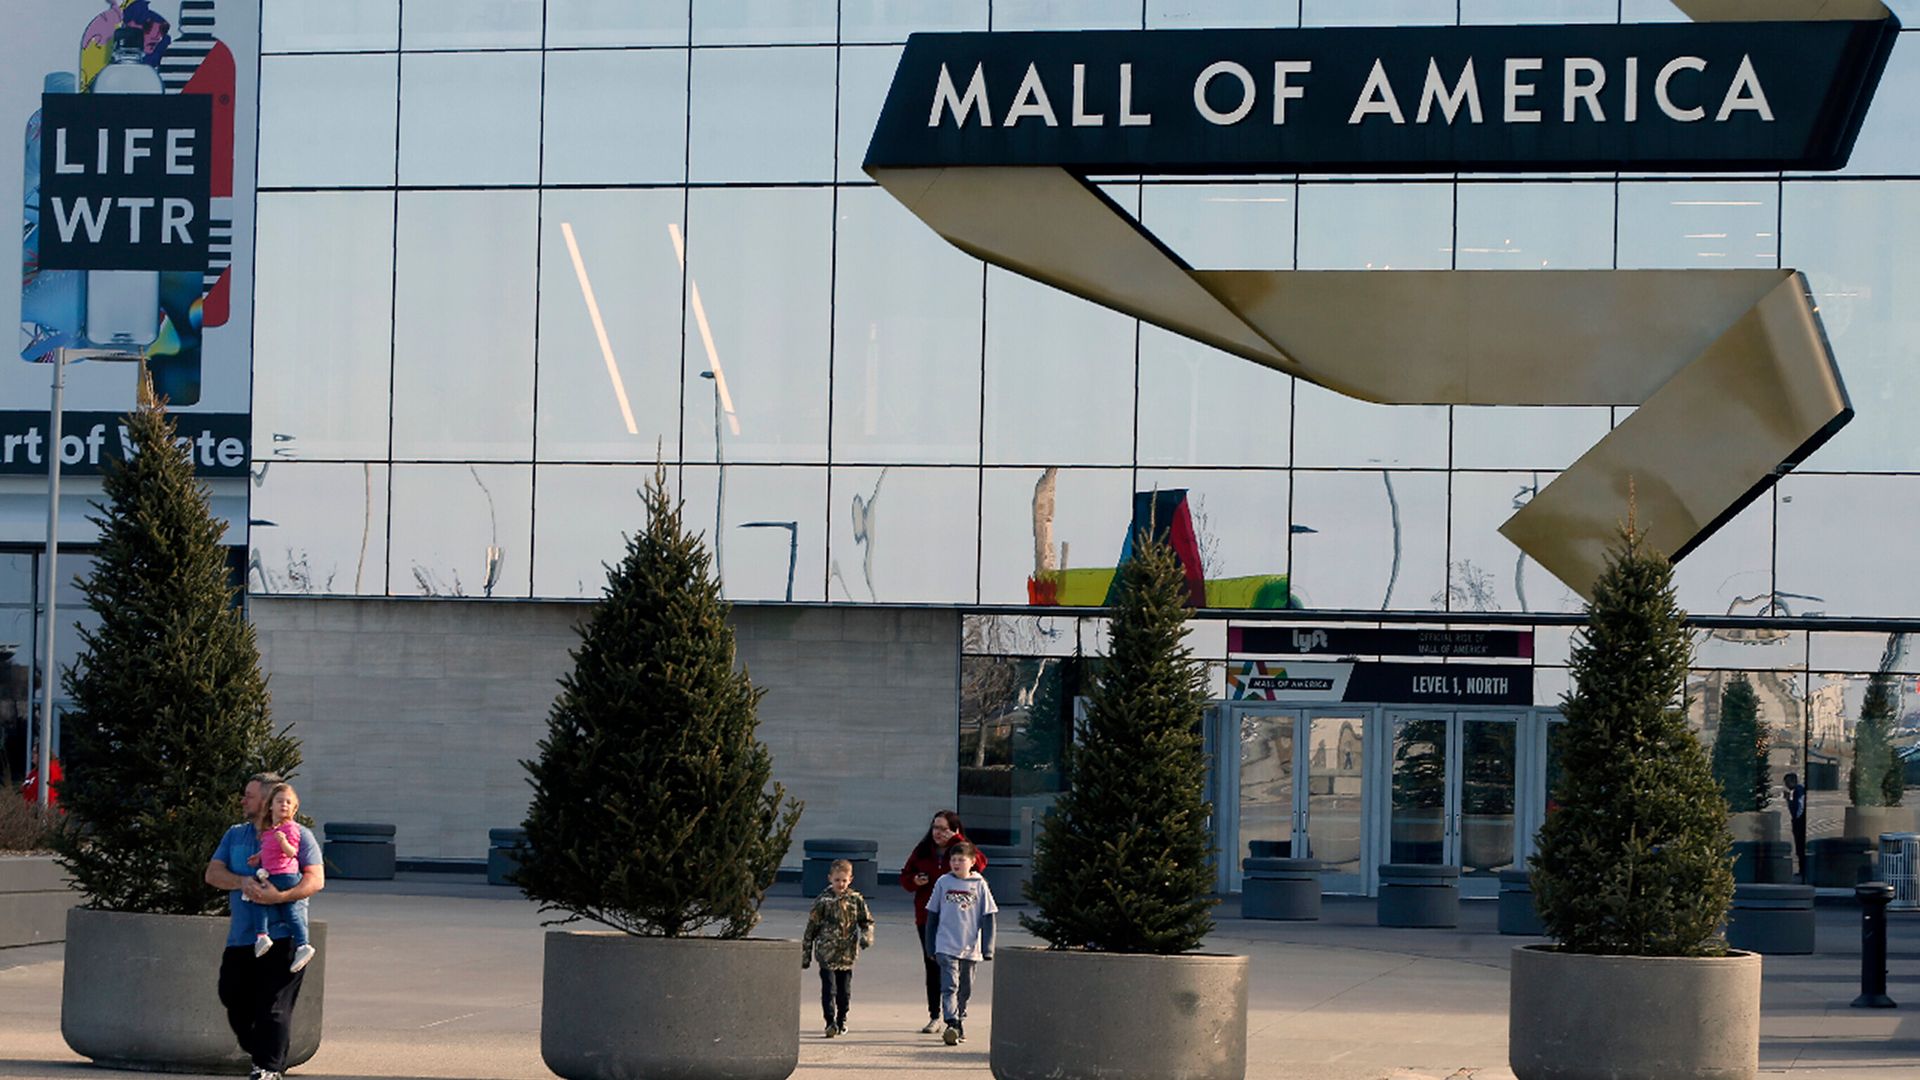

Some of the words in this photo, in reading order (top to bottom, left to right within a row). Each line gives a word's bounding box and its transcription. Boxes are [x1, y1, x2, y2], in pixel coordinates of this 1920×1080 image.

[928, 61, 1151, 130] MALL
[1194, 60, 1312, 126] OF
[1348, 53, 1776, 125] AMERICA
[55, 128, 195, 175] LIFE
[51, 197, 195, 244] WTR
[0, 427, 42, 464] rt
[60, 424, 105, 465] of
[1292, 629, 1328, 653] lyft
[1418, 644, 1439, 654] MALL
[1440, 644, 1451, 654] OF
[1253, 680, 1275, 688] MALL
[1277, 680, 1289, 688] OF
[1290, 680, 1329, 689] AMERICA
[1412, 676, 1449, 694] LEVEL
[1453, 677, 1462, 696] 1,
[1466, 677, 1509, 695] NORTH
